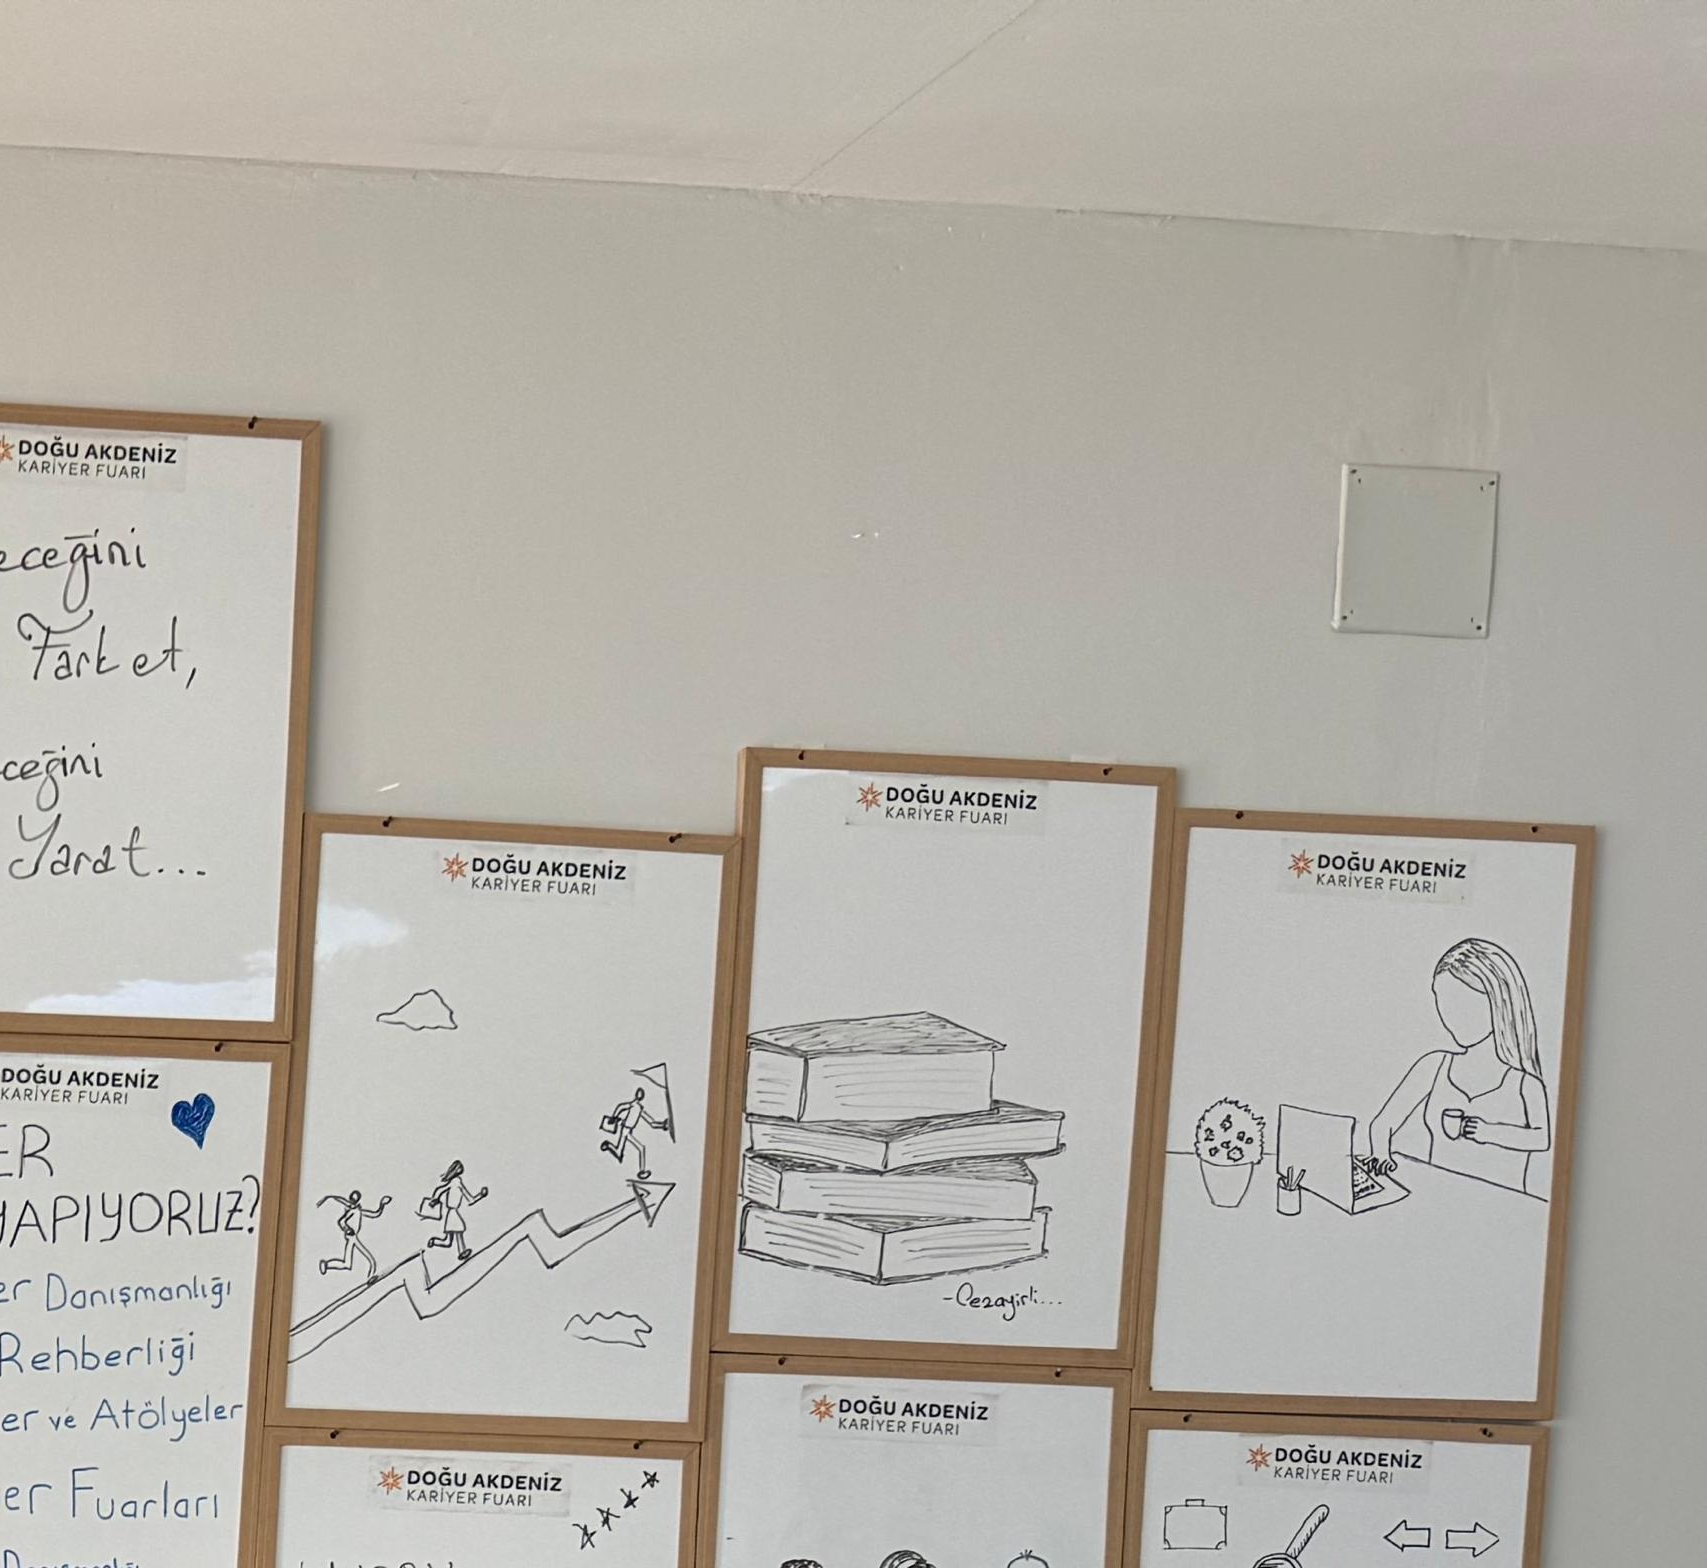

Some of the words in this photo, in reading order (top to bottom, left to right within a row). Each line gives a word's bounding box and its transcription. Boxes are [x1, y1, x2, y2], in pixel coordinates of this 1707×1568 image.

[45, 1272, 232, 1312] Danışmanlığı
[48, 1414, 77, 1432] ve
[89, 1397, 244, 1443] Atölyeler
[1273, 1463, 1342, 1482] KARİYER
[1346, 1469, 1394, 1485] FUARI
[1274, 1443, 1332, 1465] DOĞU
[1335, 1448, 1423, 1470] AKDENİZ
[71, 1466, 218, 1521] Fuarları
